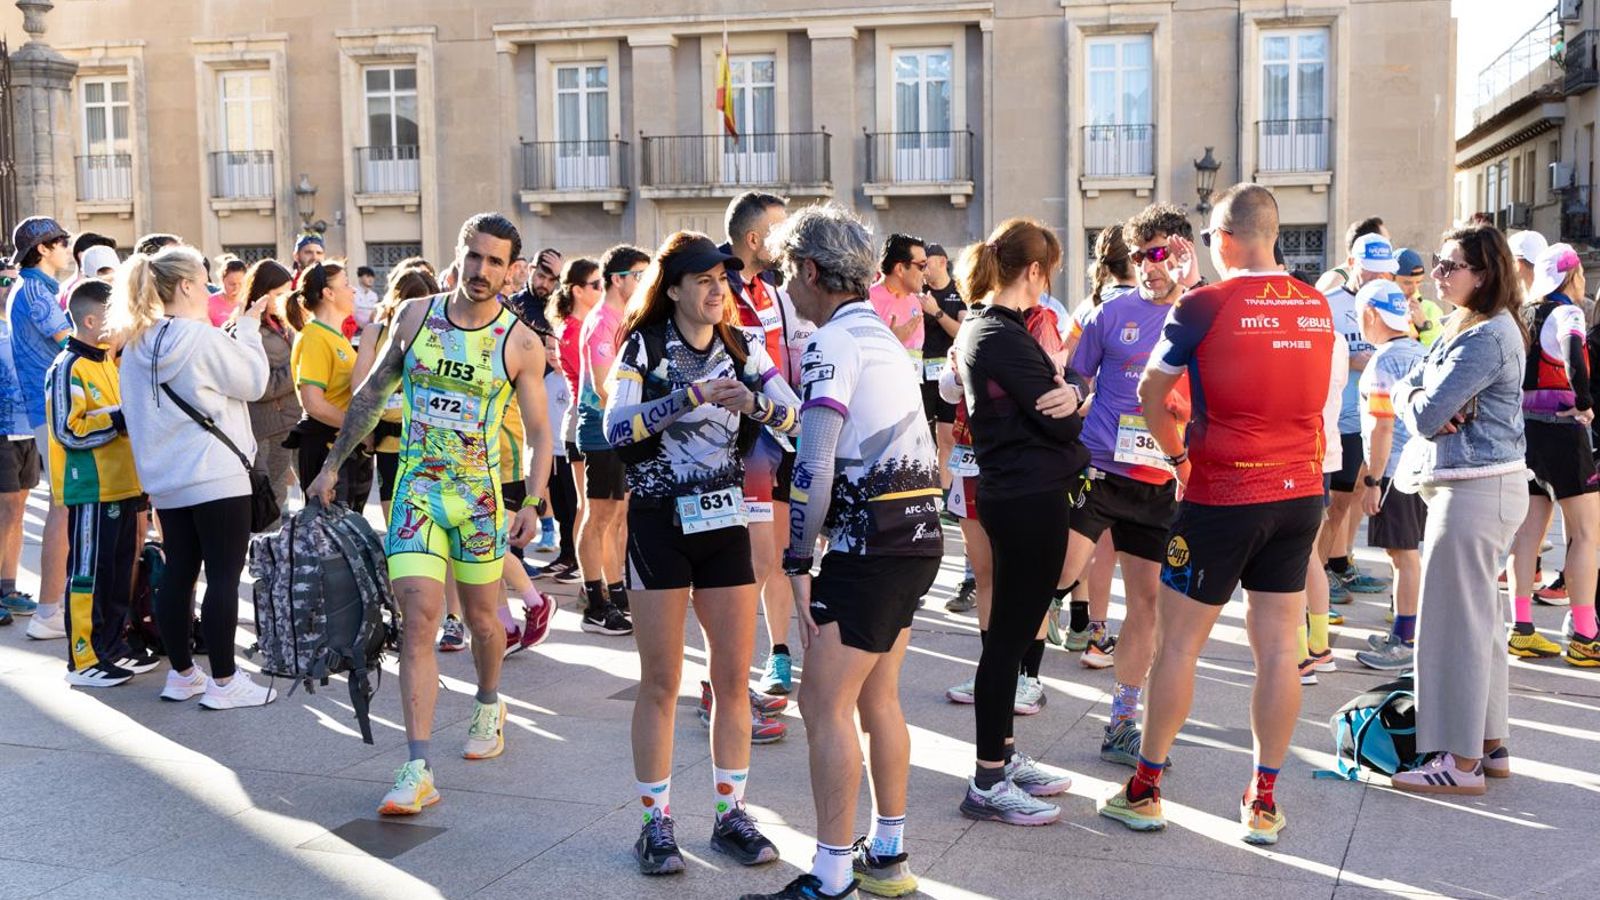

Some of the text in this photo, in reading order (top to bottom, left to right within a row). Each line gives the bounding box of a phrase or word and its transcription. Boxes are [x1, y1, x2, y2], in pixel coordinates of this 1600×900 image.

[1241, 314, 1280, 328] mics
[436, 358, 475, 381] 1153
[429, 397, 462, 413] 472
[700, 492, 733, 510] 631
[904, 504, 922, 515] AFC
